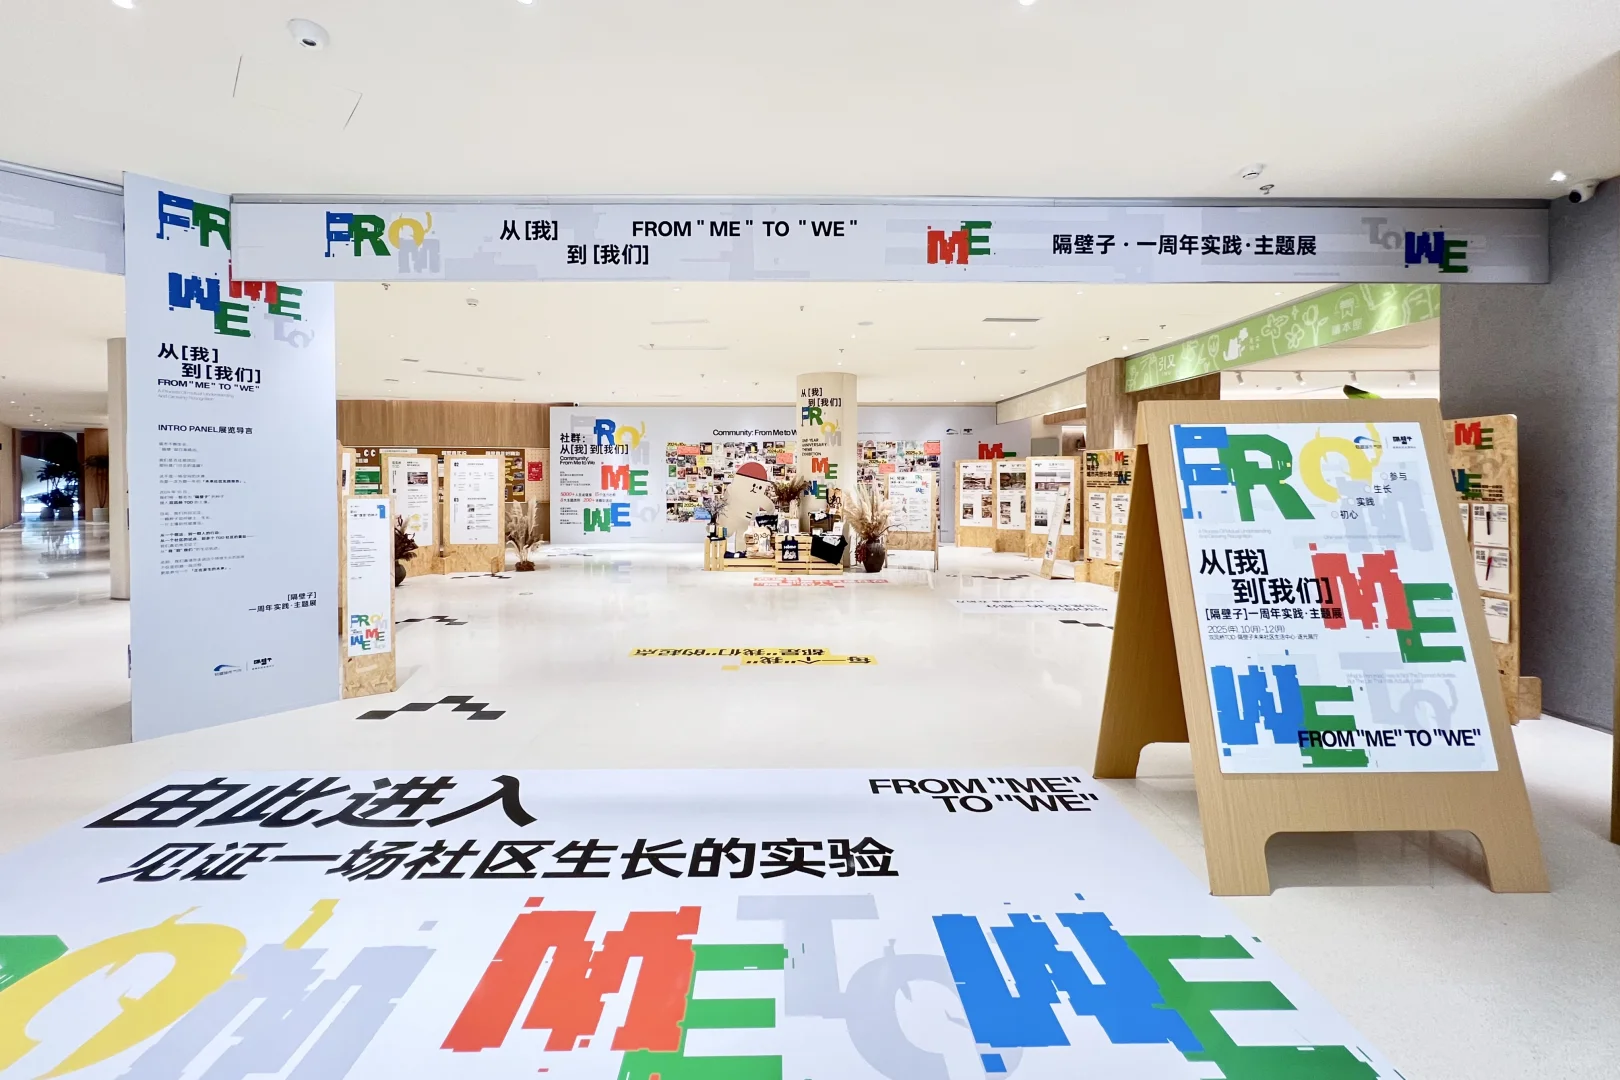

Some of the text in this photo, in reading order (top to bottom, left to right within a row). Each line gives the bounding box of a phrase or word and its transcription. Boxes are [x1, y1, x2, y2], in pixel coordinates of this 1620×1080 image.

[156, 190, 230, 250] FR
[500, 220, 558, 241] 从[我]
[632, 220, 692, 237] FROM
[763, 220, 790, 237] TO
[325, 211, 440, 273] FROM
[927, 221, 992, 264] ME
[1404, 226, 1468, 272] WE
[567, 244, 649, 265] 到[我们]
[169, 272, 250, 338] WE
[158, 343, 218, 363] 从[我]
[158, 378, 187, 387] FROM
[181, 363, 261, 383] 到[我们]
[713, 429, 753, 437] Community:
[1454, 421, 1494, 450] ME
[560, 444, 587, 454] 从[我]
[811, 457, 838, 479] ME
[1389, 472, 1408, 481] 参与
[601, 464, 649, 495] ME
[1373, 485, 1392, 494] 生长
[1356, 497, 1375, 507] 实践
[583, 503, 631, 532] WE
[1340, 510, 1359, 519] 初心
[1199, 549, 1269, 575] 从[我]
[1231, 577, 1333, 604] 到[我们]
[1311, 545, 1466, 663] ME
[351, 635, 371, 650] WE
[1210, 664, 1370, 768] WE
[1298, 730, 1355, 748] FROM
[1404, 730, 1432, 747] TO
[869, 778, 984, 795] FROM
[83, 775, 538, 829] 由此进入
[931, 795, 992, 812] TO
[97, 836, 899, 884] 见证一场社区生长的实验
[441, 897, 796, 1080] ME
[932, 893, 1405, 1080] WE
